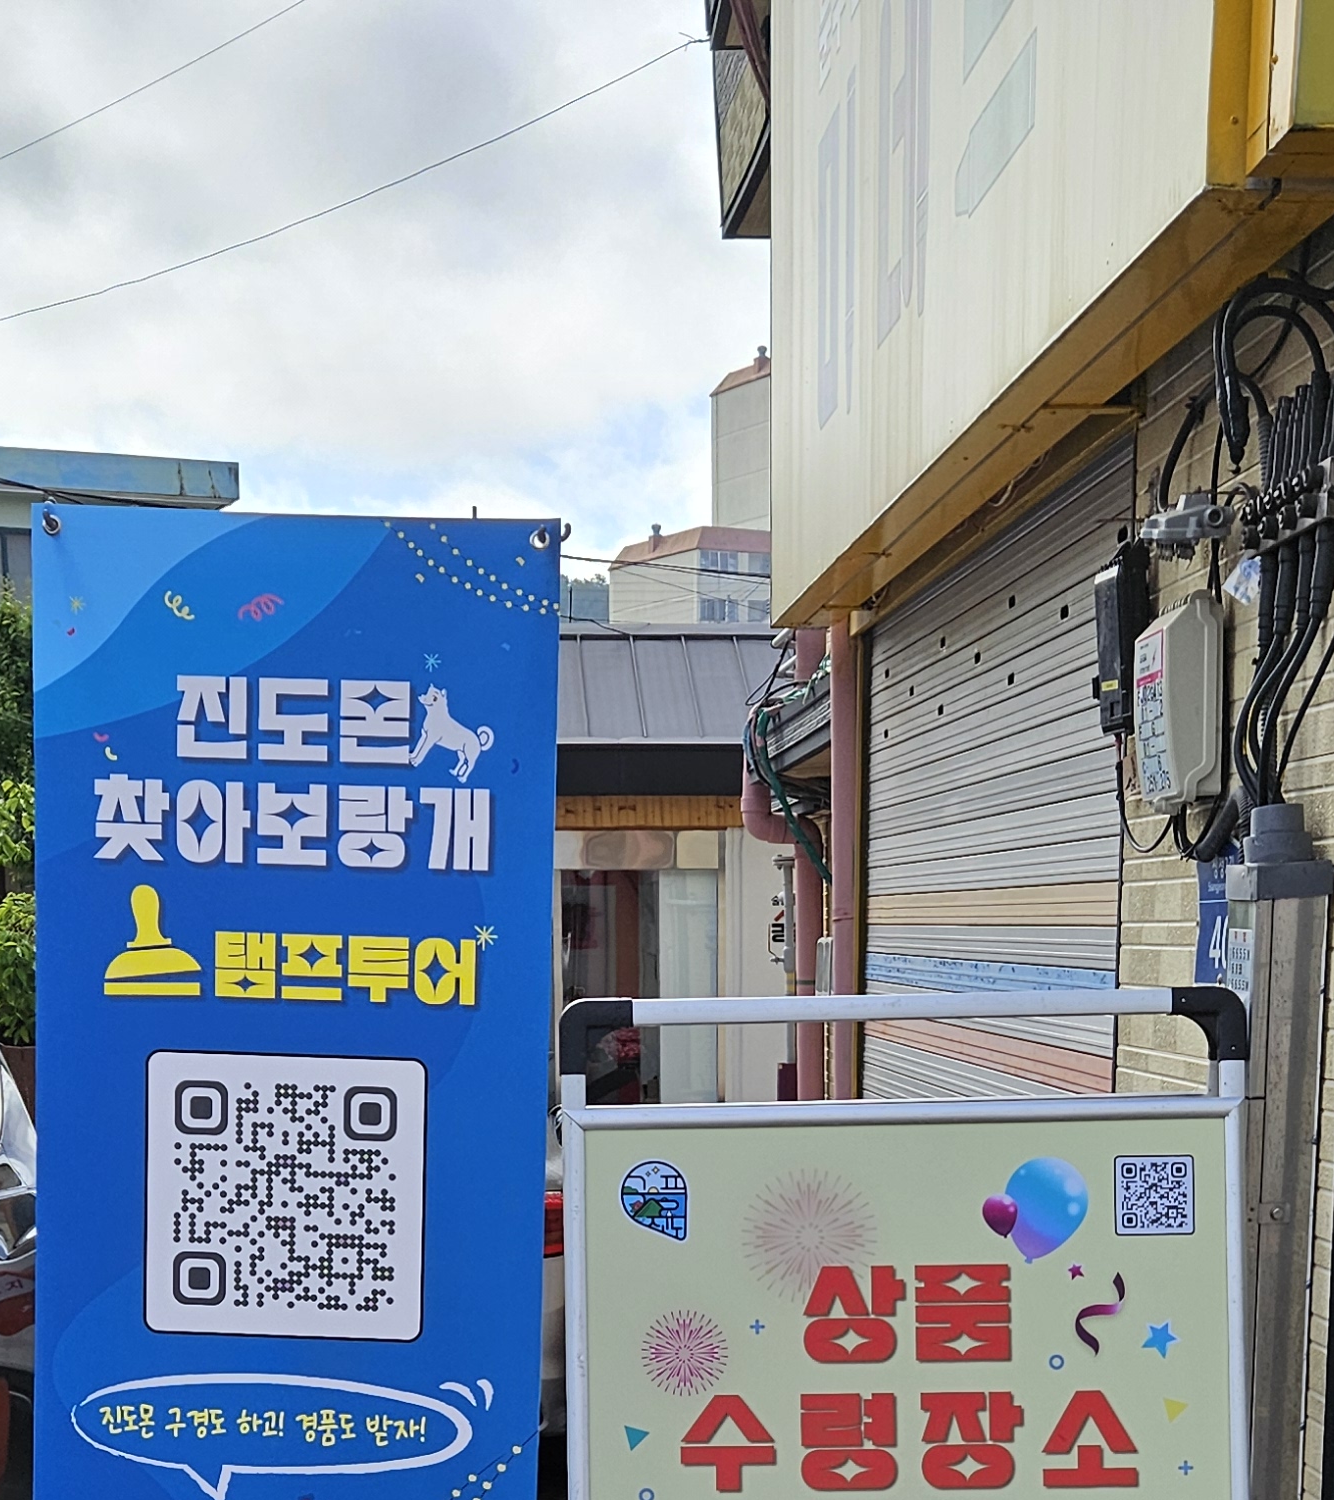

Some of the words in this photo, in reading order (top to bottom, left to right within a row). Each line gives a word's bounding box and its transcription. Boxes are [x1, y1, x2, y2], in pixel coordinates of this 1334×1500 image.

[176, 674, 411, 764] 진도몬
[94, 774, 490, 871] 찾아보랑개
[803, 1264, 1012, 1364] 상품
[100, 1404, 155, 1438] 진도몬
[165, 1407, 227, 1439] 구경도
[236, 1410, 285, 1437] 하고!
[296, 1409, 356, 1447] 경품도
[366, 1416, 427, 1447] 받자!
[680, 1390, 1140, 1492] 수령장소
